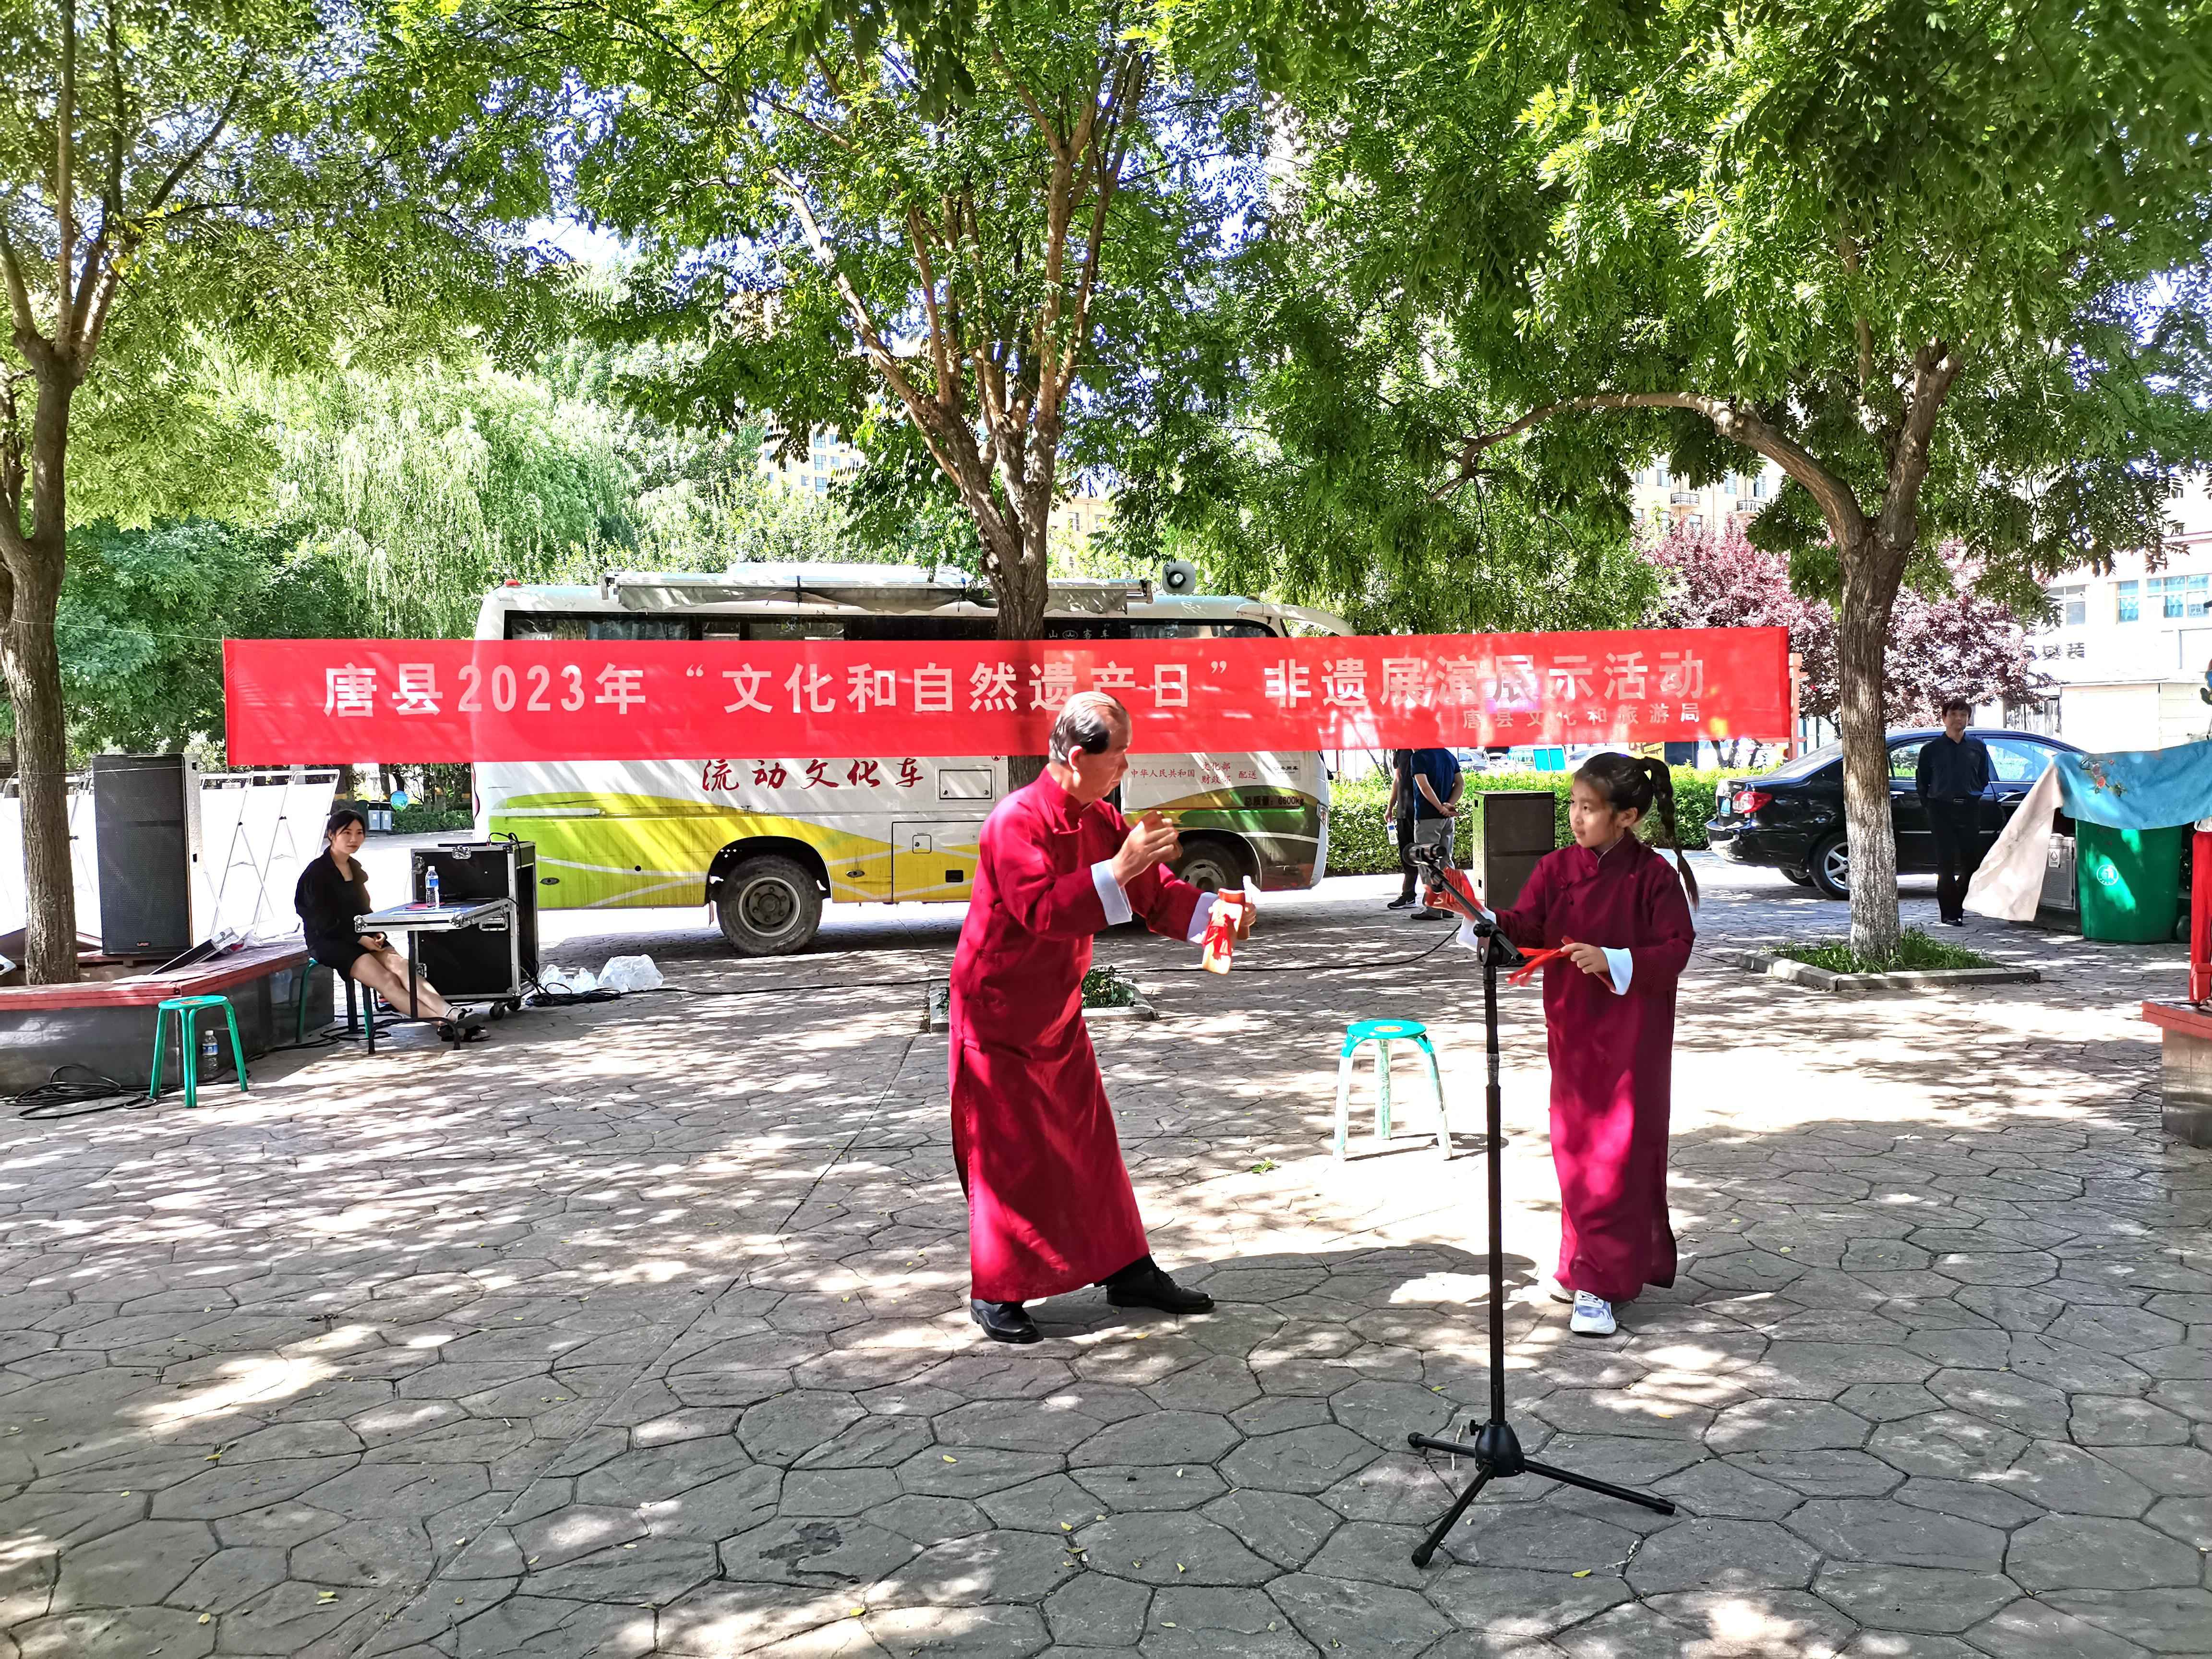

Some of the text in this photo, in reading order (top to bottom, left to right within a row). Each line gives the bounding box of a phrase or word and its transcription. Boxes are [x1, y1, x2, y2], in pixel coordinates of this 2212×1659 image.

[1462, 702, 1700, 729] 唐县文化和旅游局
[1202, 761, 1230, 771] 文化部
[702, 757, 924, 791] 流动文化车
[1130, 769, 1195, 778] 中华人民共和国
[1238, 769, 1257, 780] 配送
[1201, 775, 1231, 784] 财政部
